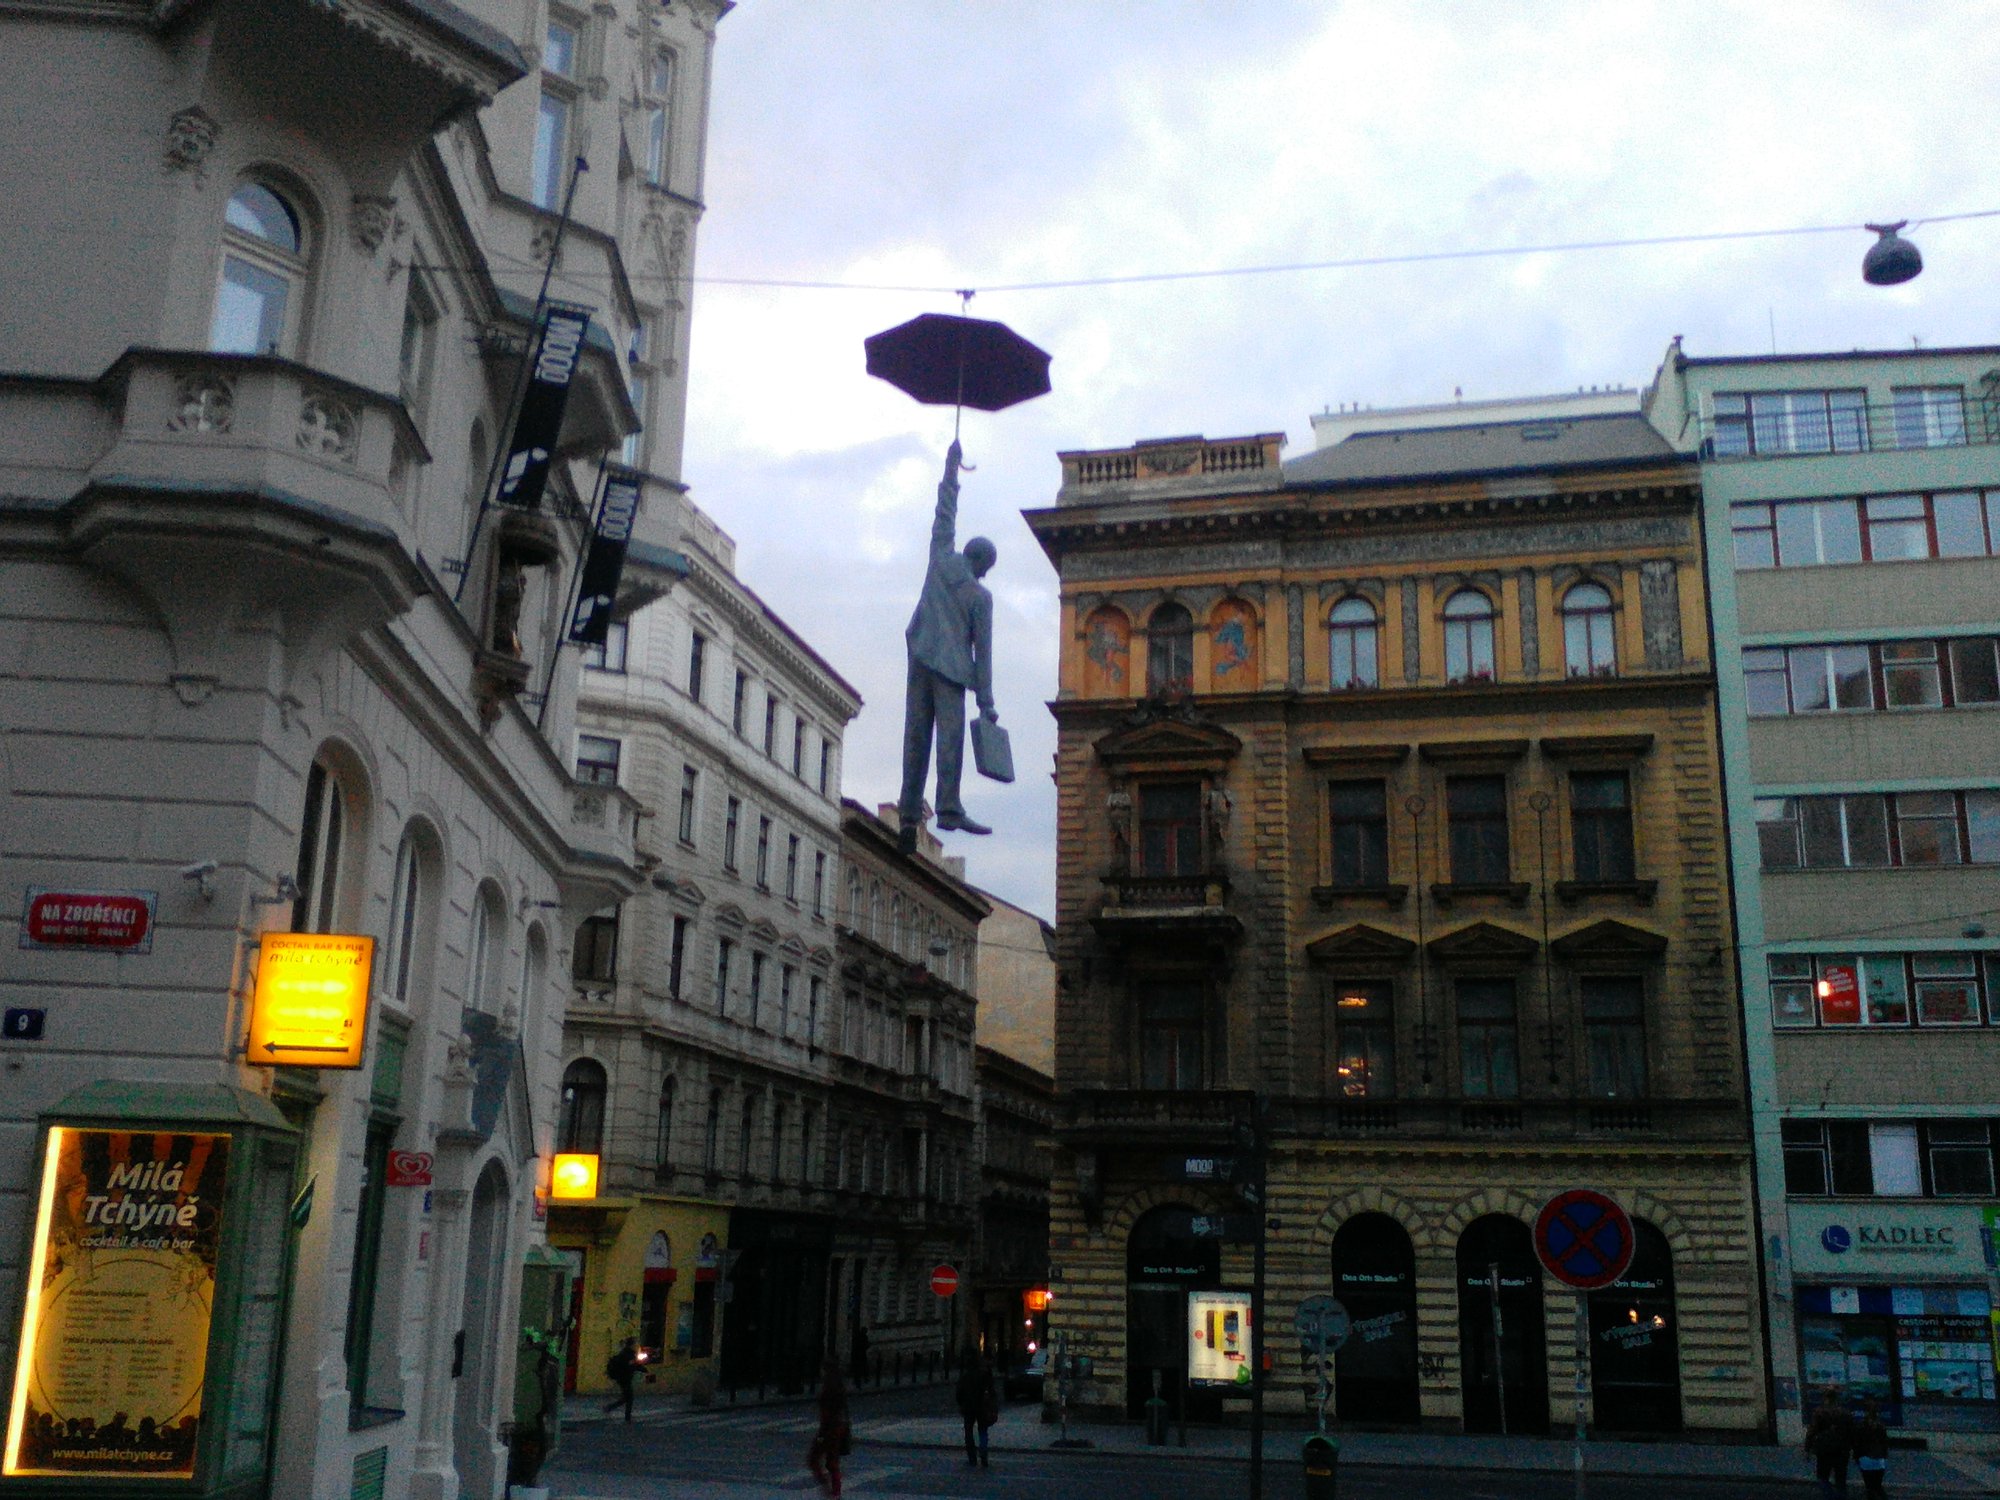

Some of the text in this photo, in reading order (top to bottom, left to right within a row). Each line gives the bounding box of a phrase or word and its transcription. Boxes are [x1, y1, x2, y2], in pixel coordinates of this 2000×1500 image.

[41, 902, 137, 925] NA ZBOŘENCI
[270, 941, 310, 950] COCTAIL
[314, 942, 333, 950] BAR
[346, 943, 365, 952] PUB
[18, 1014, 29, 1031] 9
[107, 1160, 185, 1192] Milá
[85, 1193, 200, 1232] Tchýně
[80, 1236, 128, 1249] cocktail
[130, 1237, 139, 1248] &
[172, 1237, 196, 1249] bar
[1858, 1226, 1954, 1245] KADLEC
